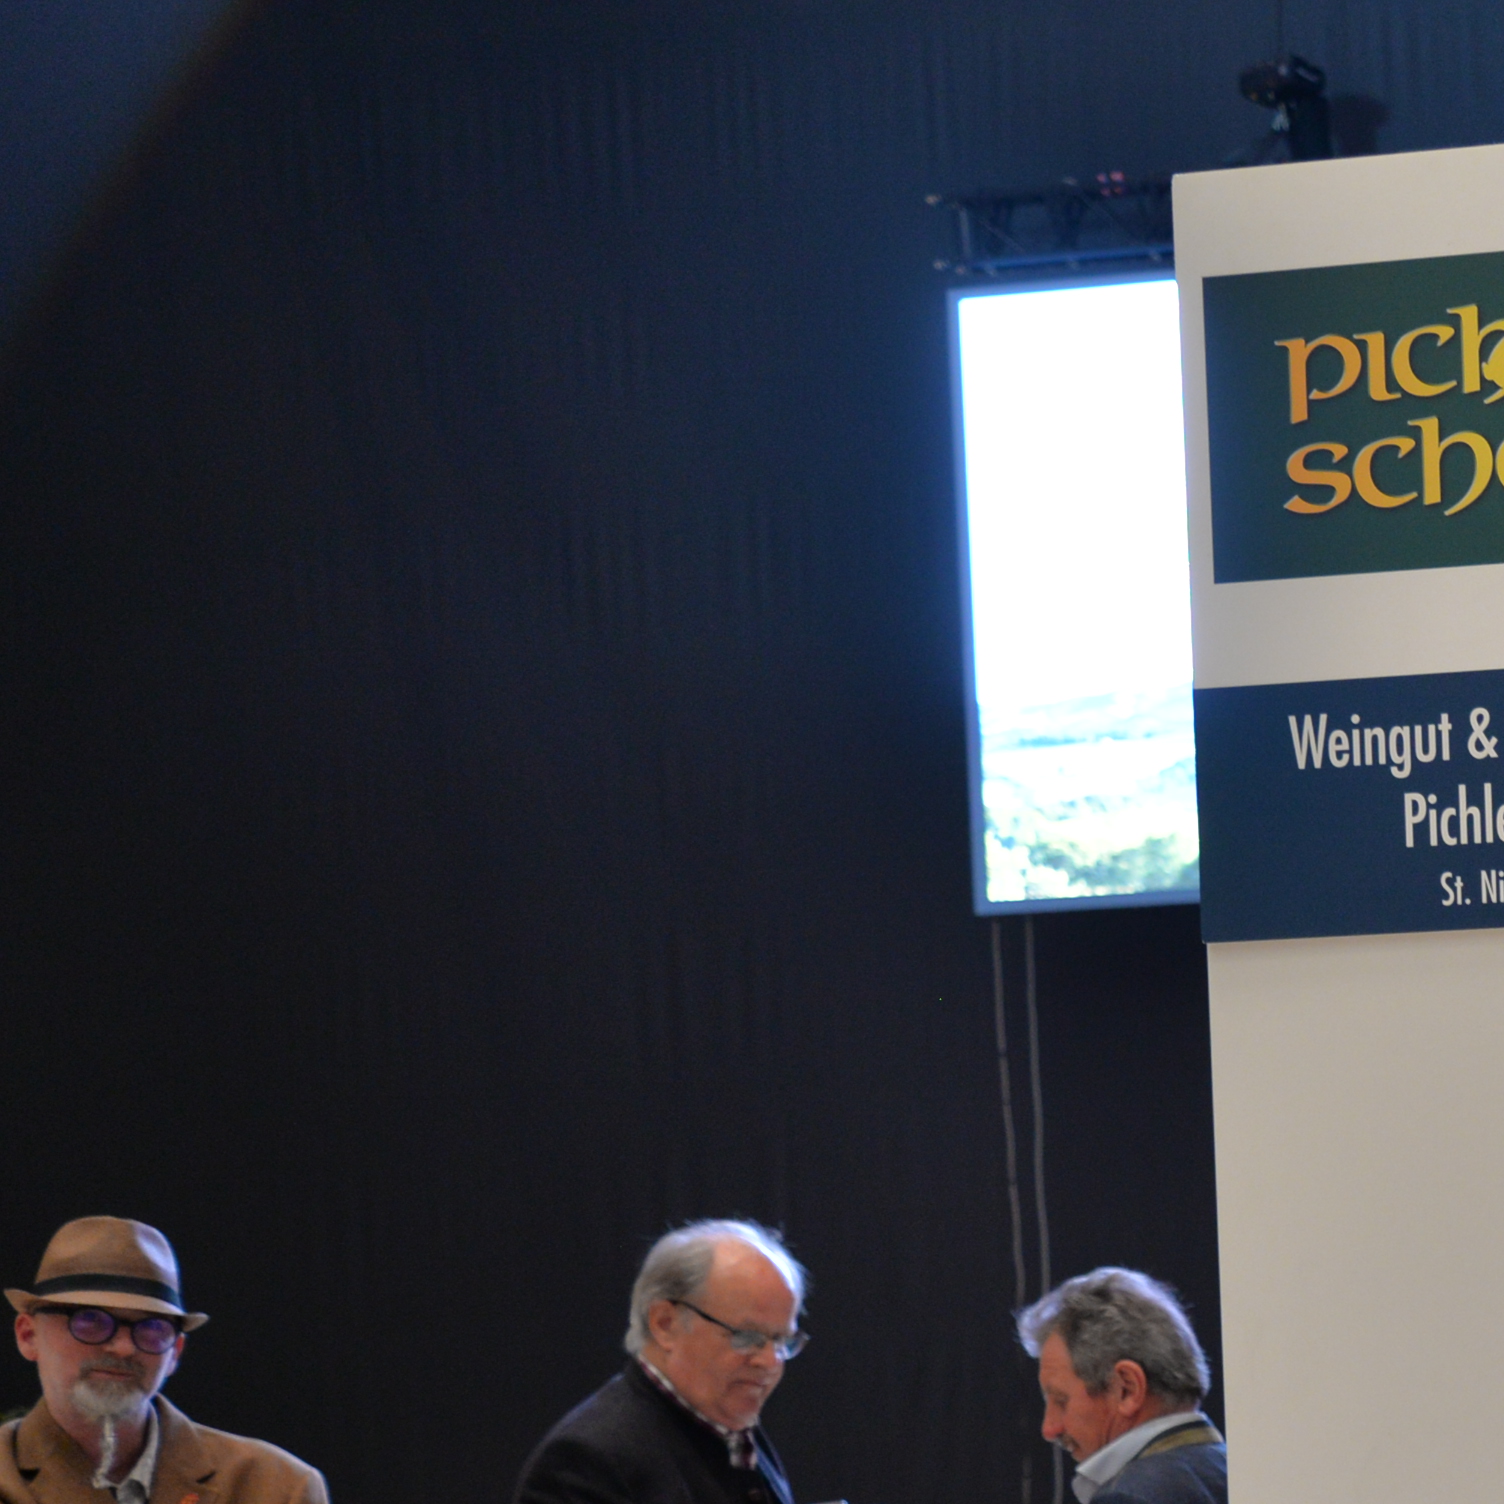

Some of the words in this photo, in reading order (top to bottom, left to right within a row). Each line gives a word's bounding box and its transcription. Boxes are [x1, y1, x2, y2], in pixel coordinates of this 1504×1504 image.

[1289, 713, 1453, 778] Weingut
[1467, 707, 1499, 760] &
[1440, 874, 1472, 908] St.
